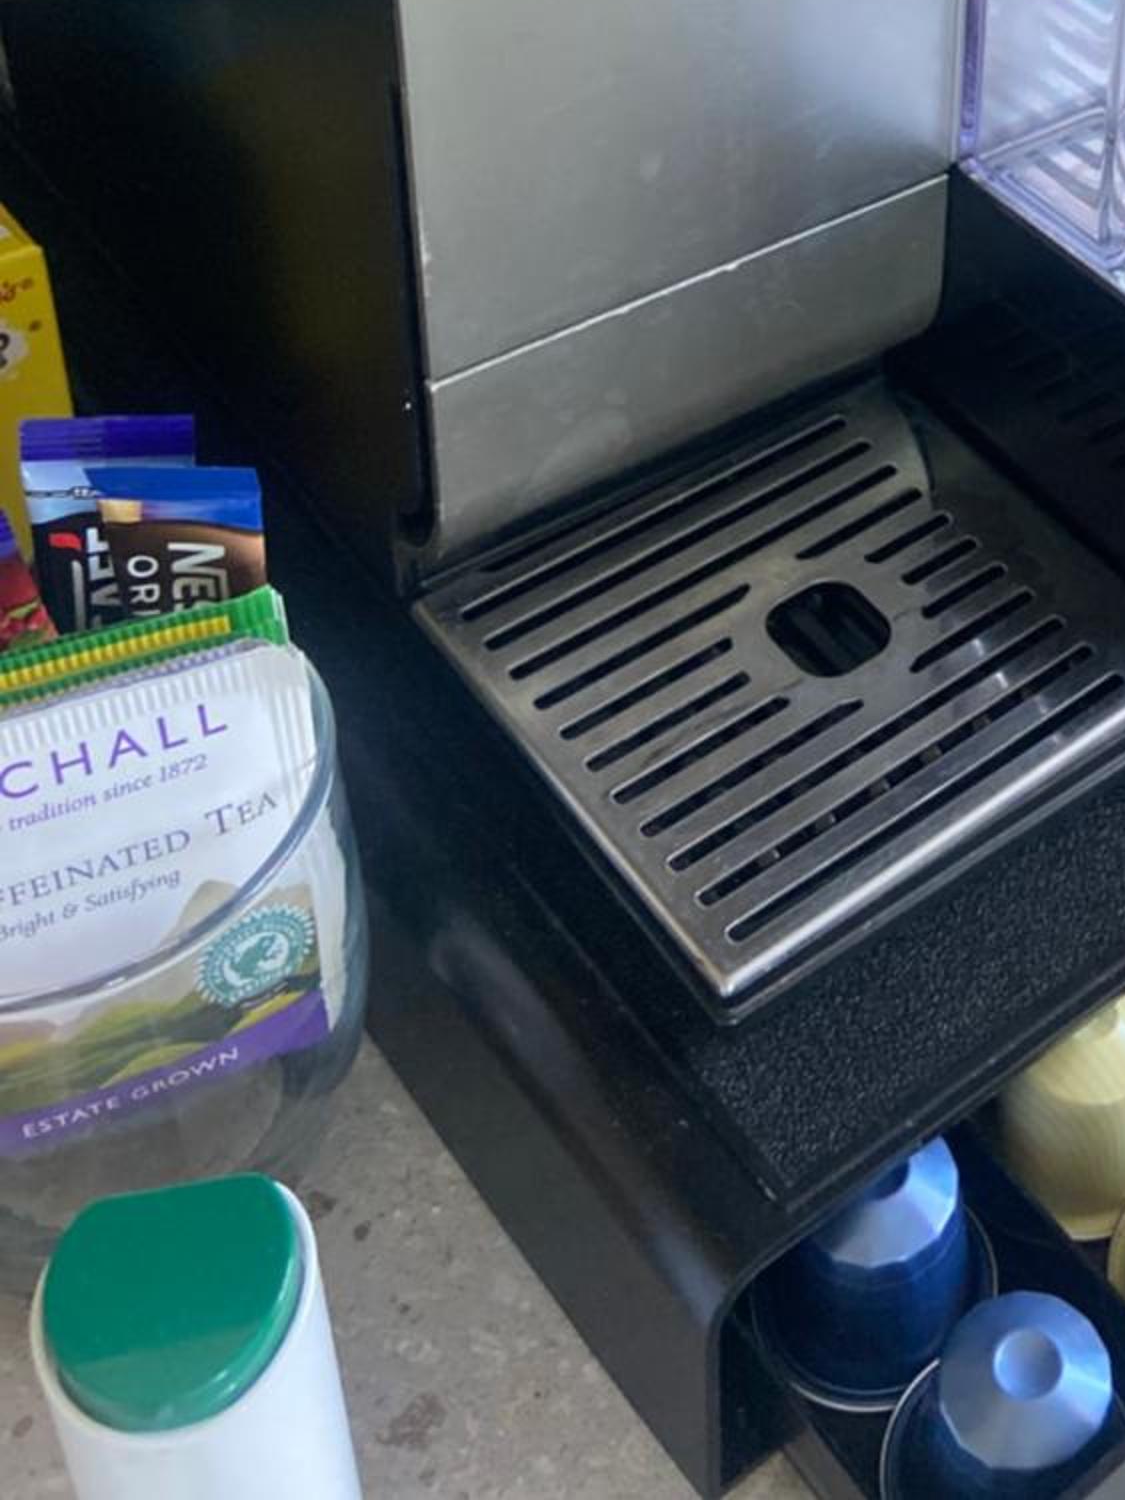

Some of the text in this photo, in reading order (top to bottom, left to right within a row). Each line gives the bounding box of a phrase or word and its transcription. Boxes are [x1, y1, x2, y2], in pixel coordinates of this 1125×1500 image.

[0, 705, 228, 798] CHALL
[9, 753, 208, 831] tradition since 1872
[62, 902, 79, 919] &
[85, 870, 180, 913] Satisfying
[22, 1047, 239, 1139] ESTATE GROWN
